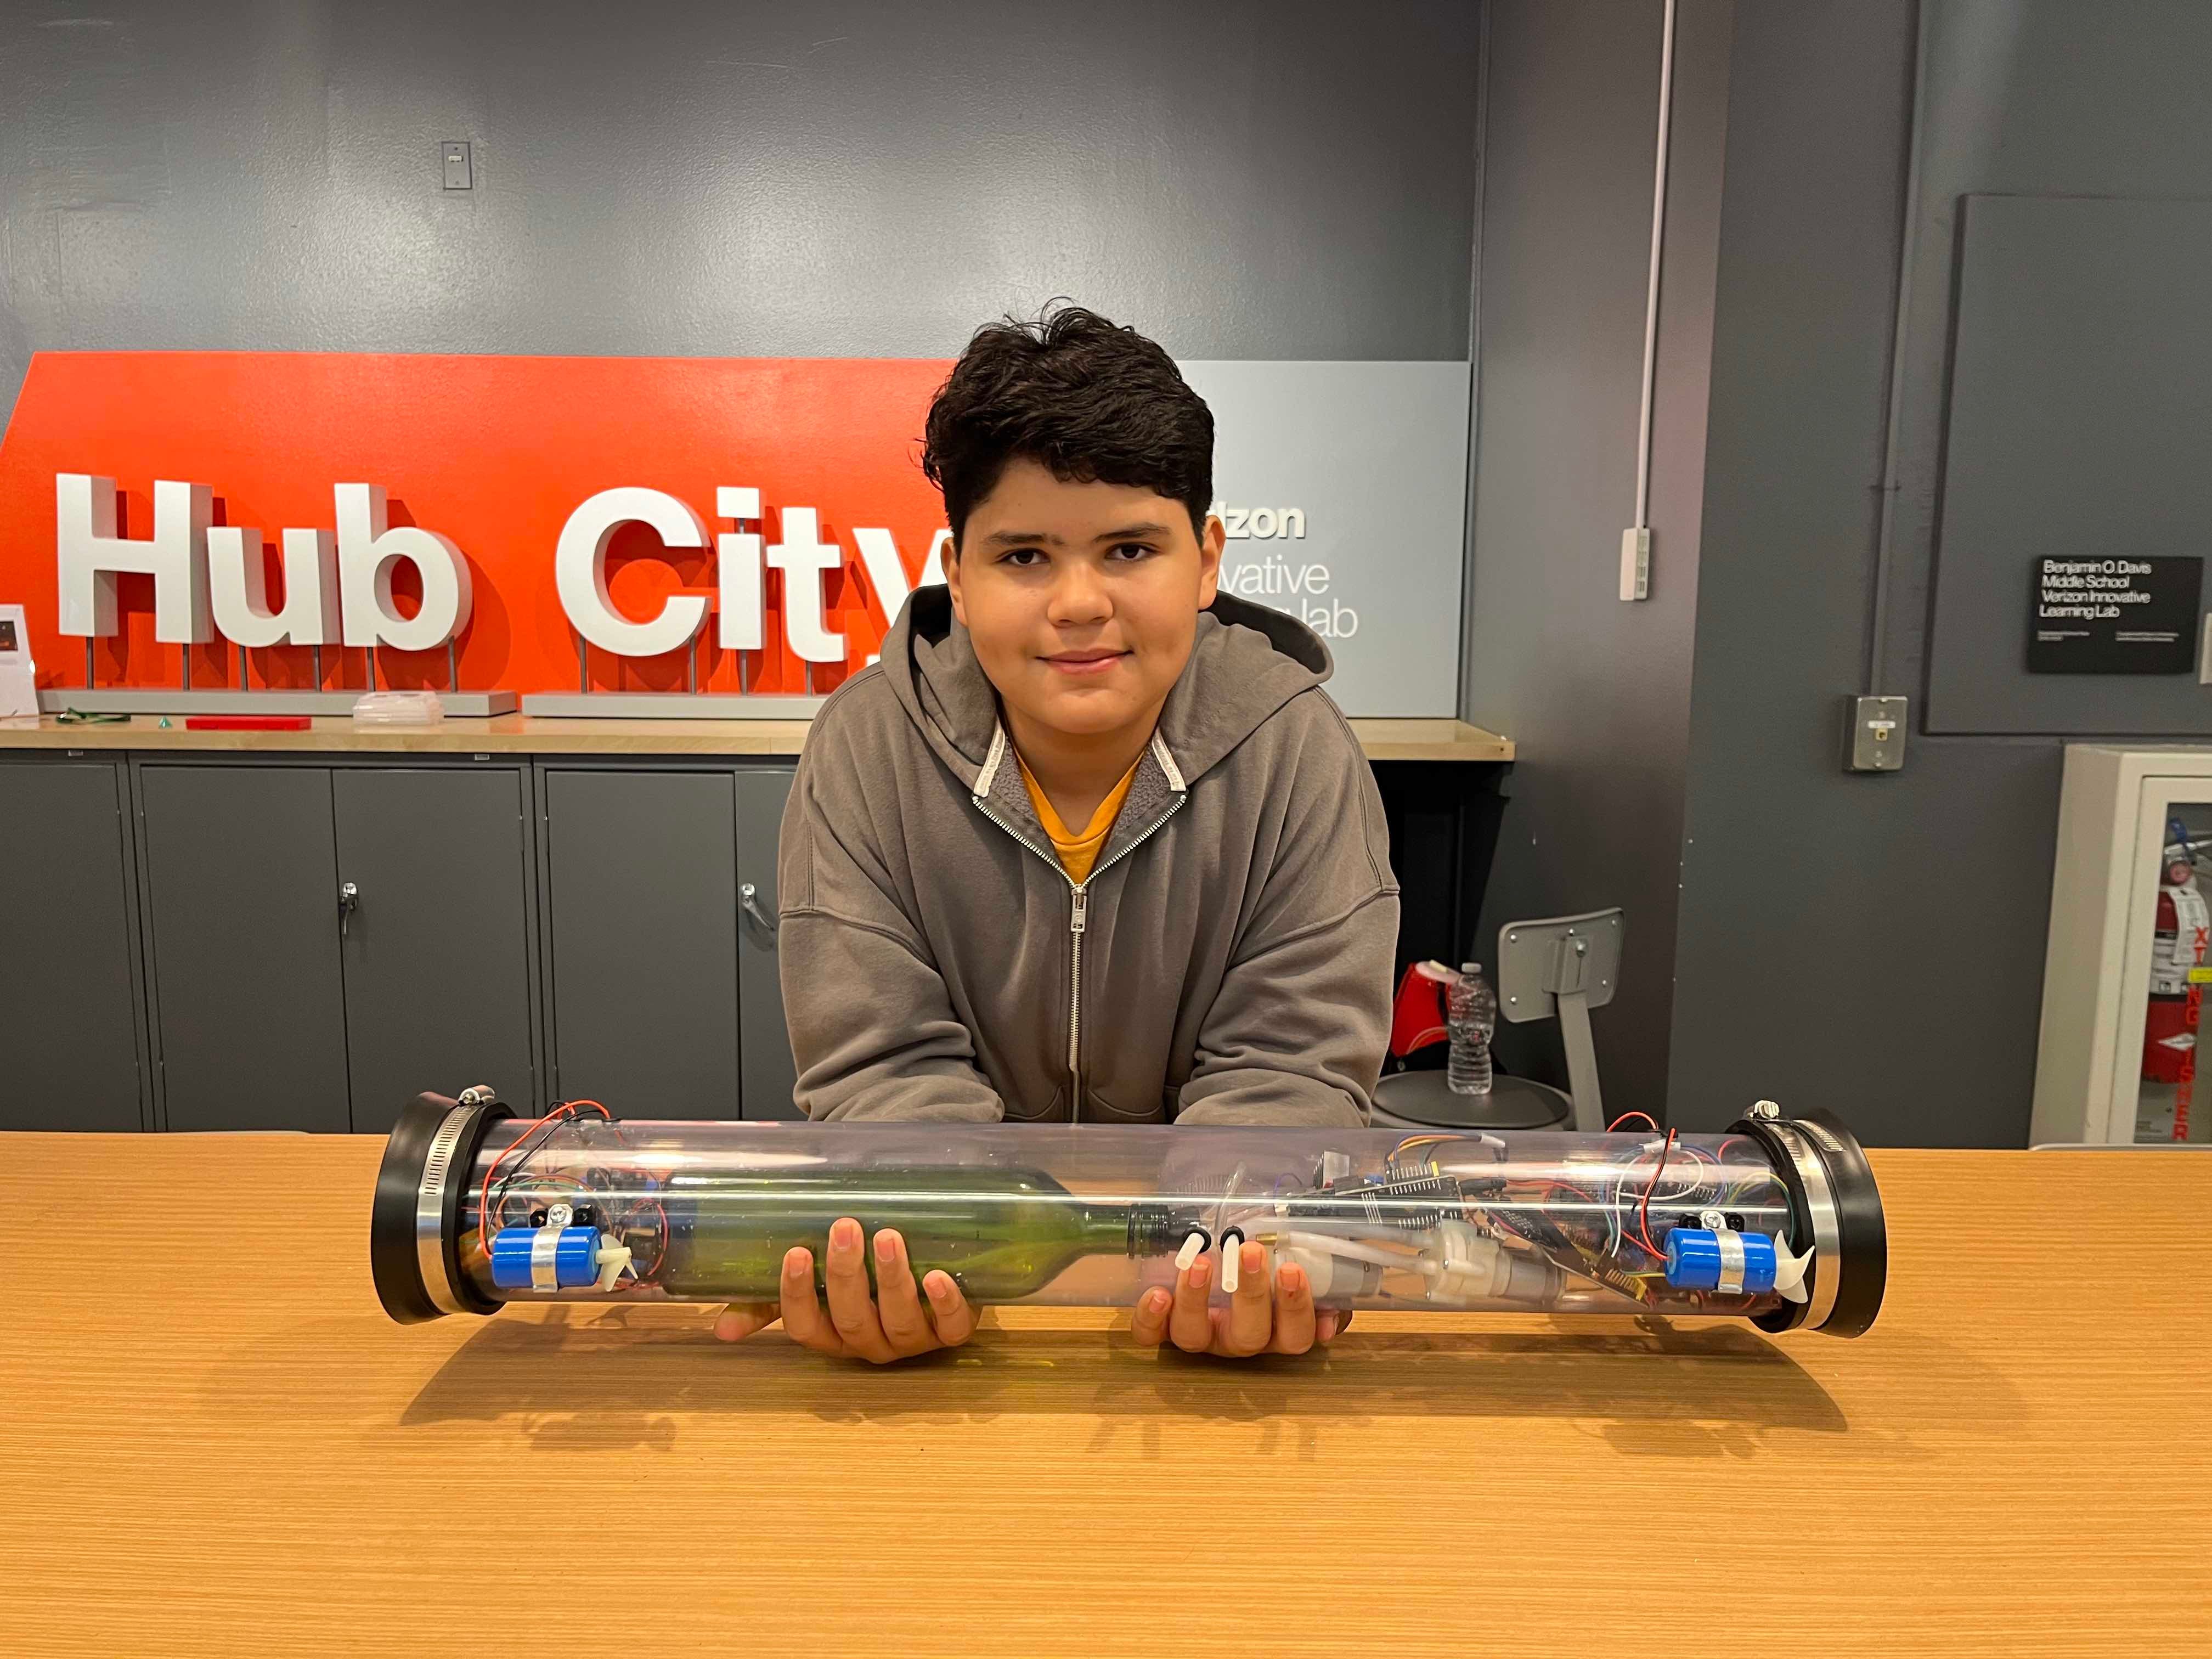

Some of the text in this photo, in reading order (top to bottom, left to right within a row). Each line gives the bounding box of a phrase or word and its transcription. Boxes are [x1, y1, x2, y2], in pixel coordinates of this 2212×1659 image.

[1206, 502, 1306, 539] izon
[57, 472, 473, 651] Hub
[2044, 559, 2101, 575] Benjamin
[2117, 560, 2152, 574] Davis
[1216, 554, 1330, 594] vative
[2041, 574, 2130, 589] Middle School
[2041, 589, 2151, 603] Verizon Innovative
[2039, 603, 2120, 620] Learning Lab
